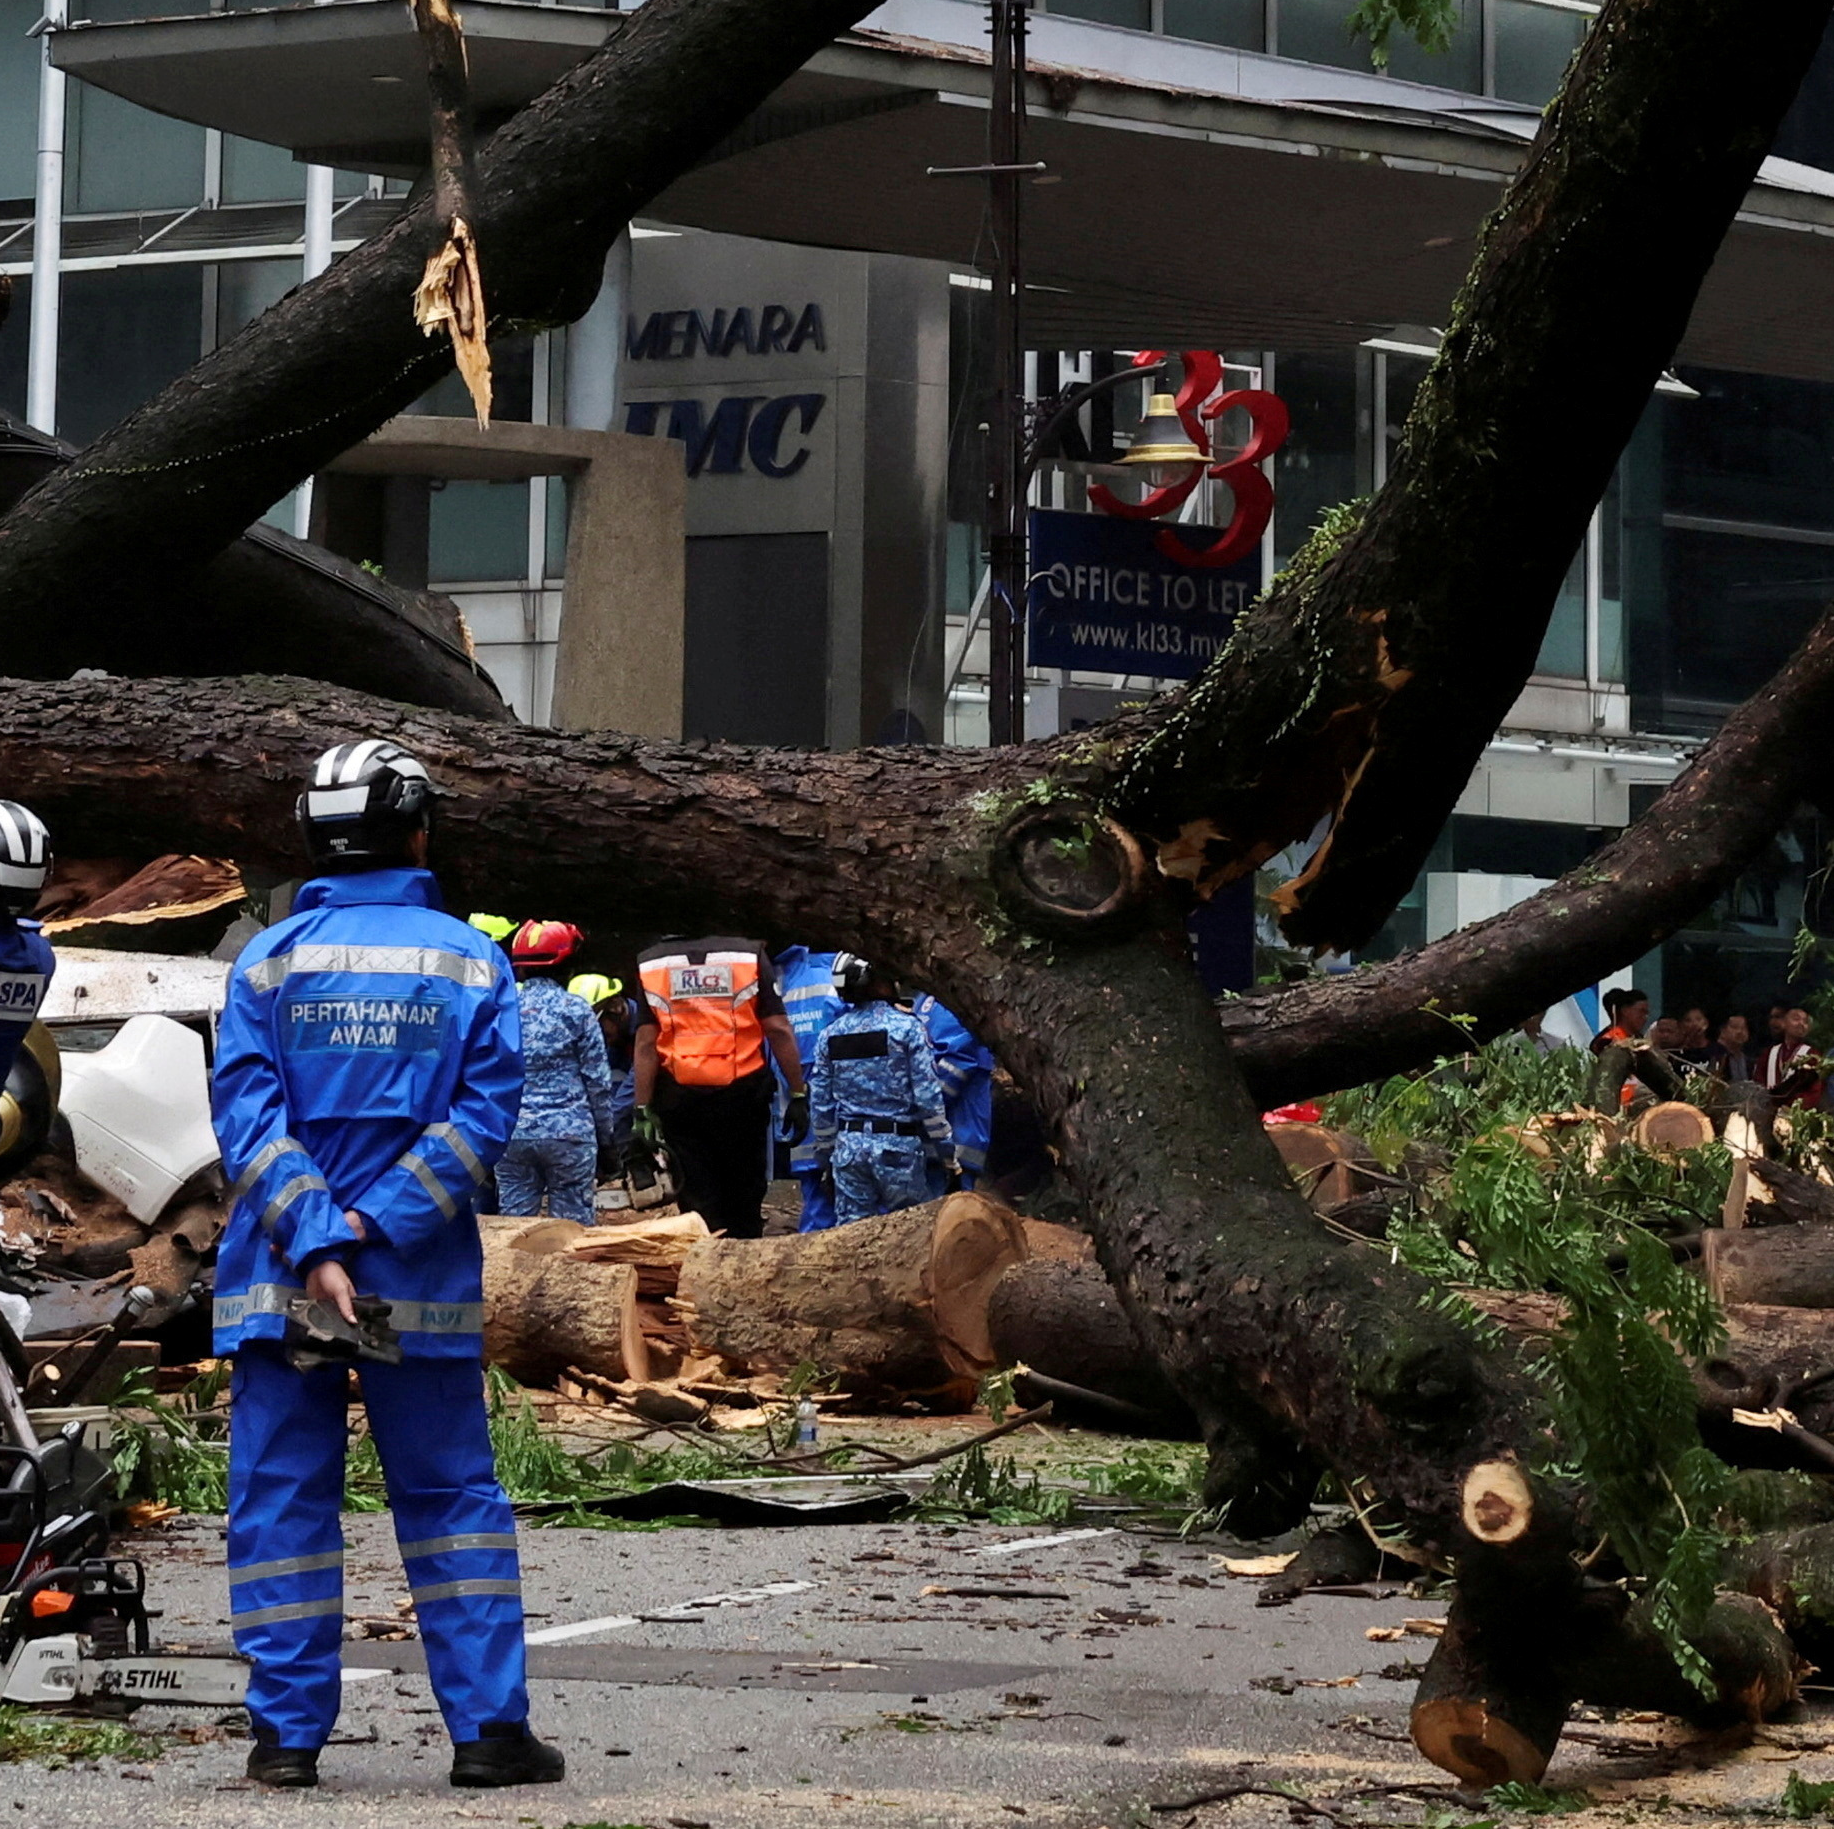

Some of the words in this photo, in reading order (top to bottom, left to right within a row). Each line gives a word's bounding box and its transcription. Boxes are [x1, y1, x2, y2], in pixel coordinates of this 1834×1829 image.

[1047, 562, 1150, 606] OFFICE
[1160, 575, 1196, 610] TO
[1208, 579, 1248, 615] LET
[290, 1001, 439, 1026] PERTAHANAN
[329, 1024, 397, 1046] AWAM
[124, 1669, 183, 1689] STIHL
